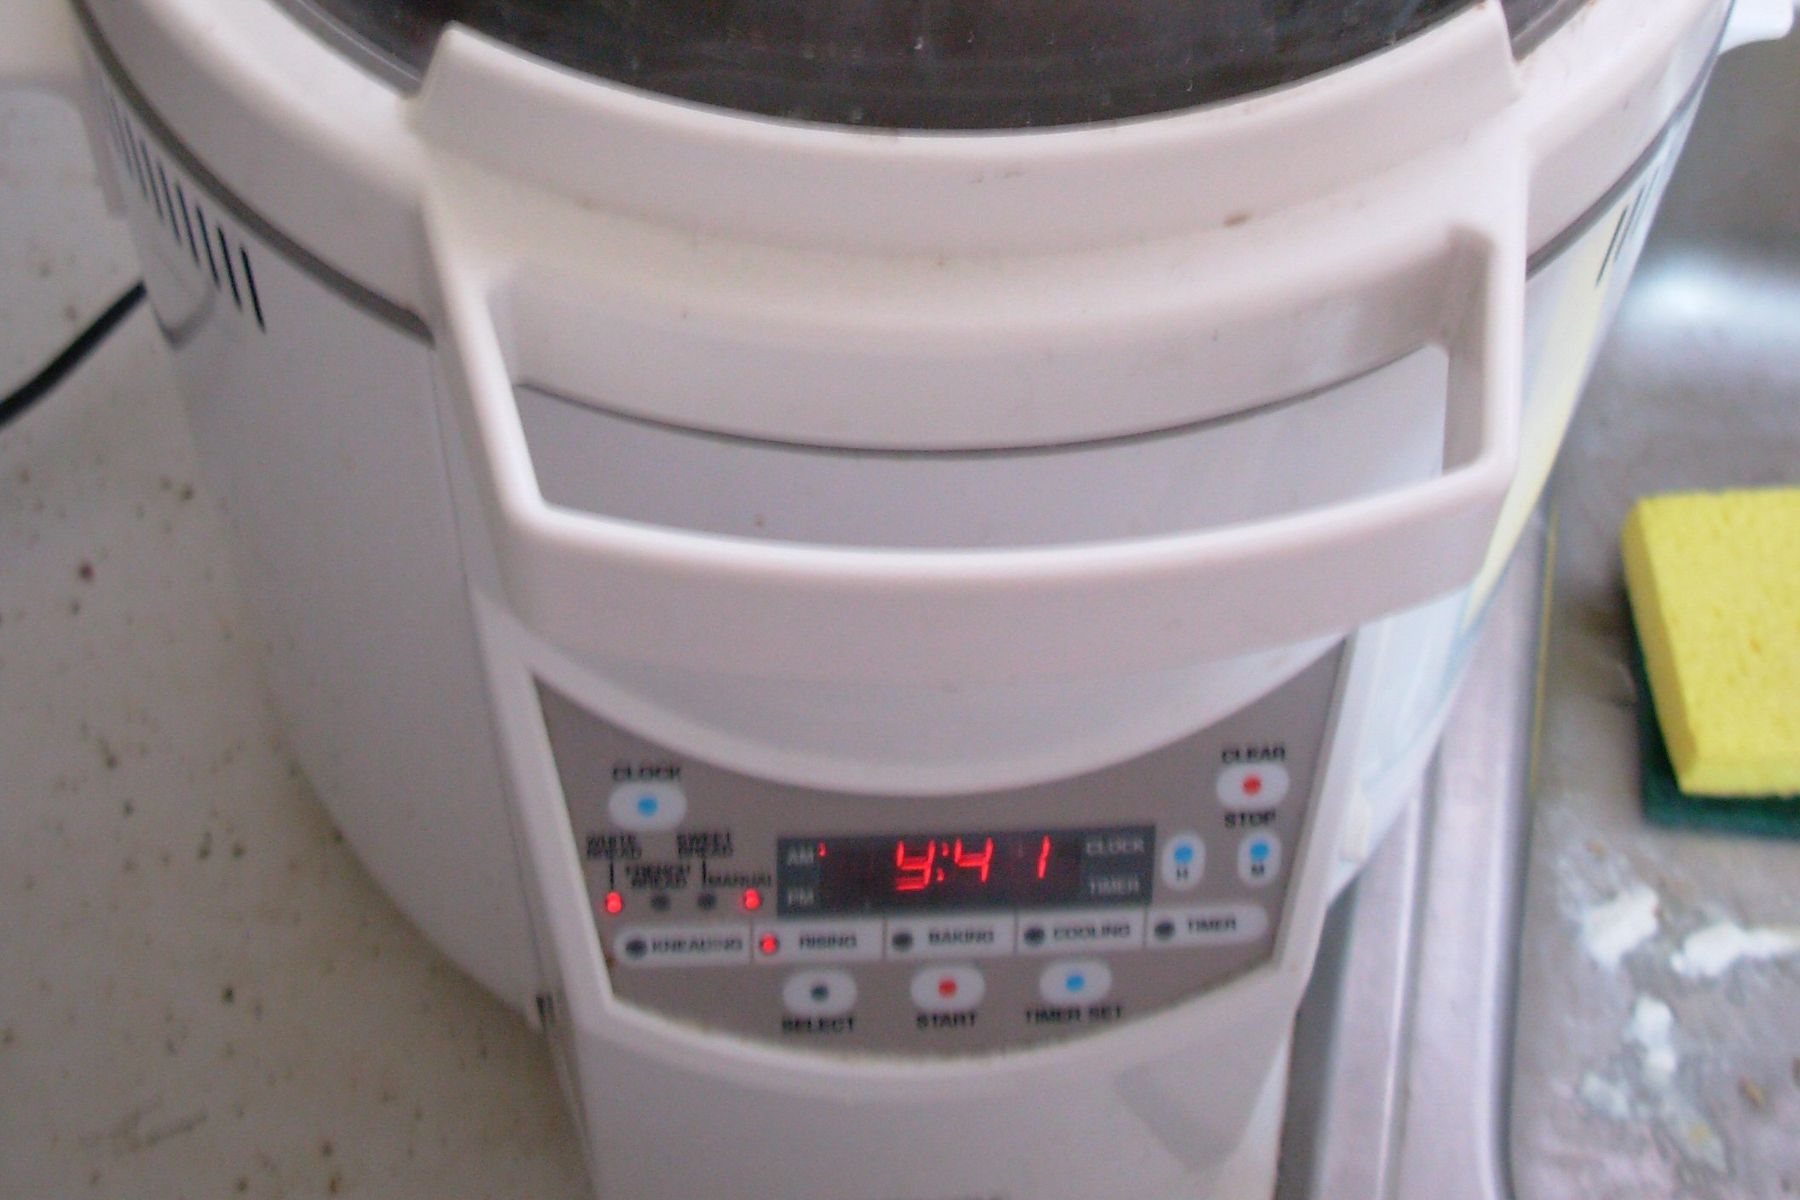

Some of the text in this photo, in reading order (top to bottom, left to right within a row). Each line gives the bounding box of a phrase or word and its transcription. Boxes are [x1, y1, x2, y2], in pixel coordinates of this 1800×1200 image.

[1220, 746, 1286, 764] CLEAR
[1224, 809, 1276, 828] STOP
[1054, 922, 1131, 942] COOLING
[1188, 915, 1237, 933] TIMER
[800, 933, 858, 951] RISING
[929, 929, 995, 946] BAKING
[915, 1011, 976, 1030] START
[1026, 1002, 1124, 1025] TIMER SET
[783, 1016, 855, 1034] SELECT
